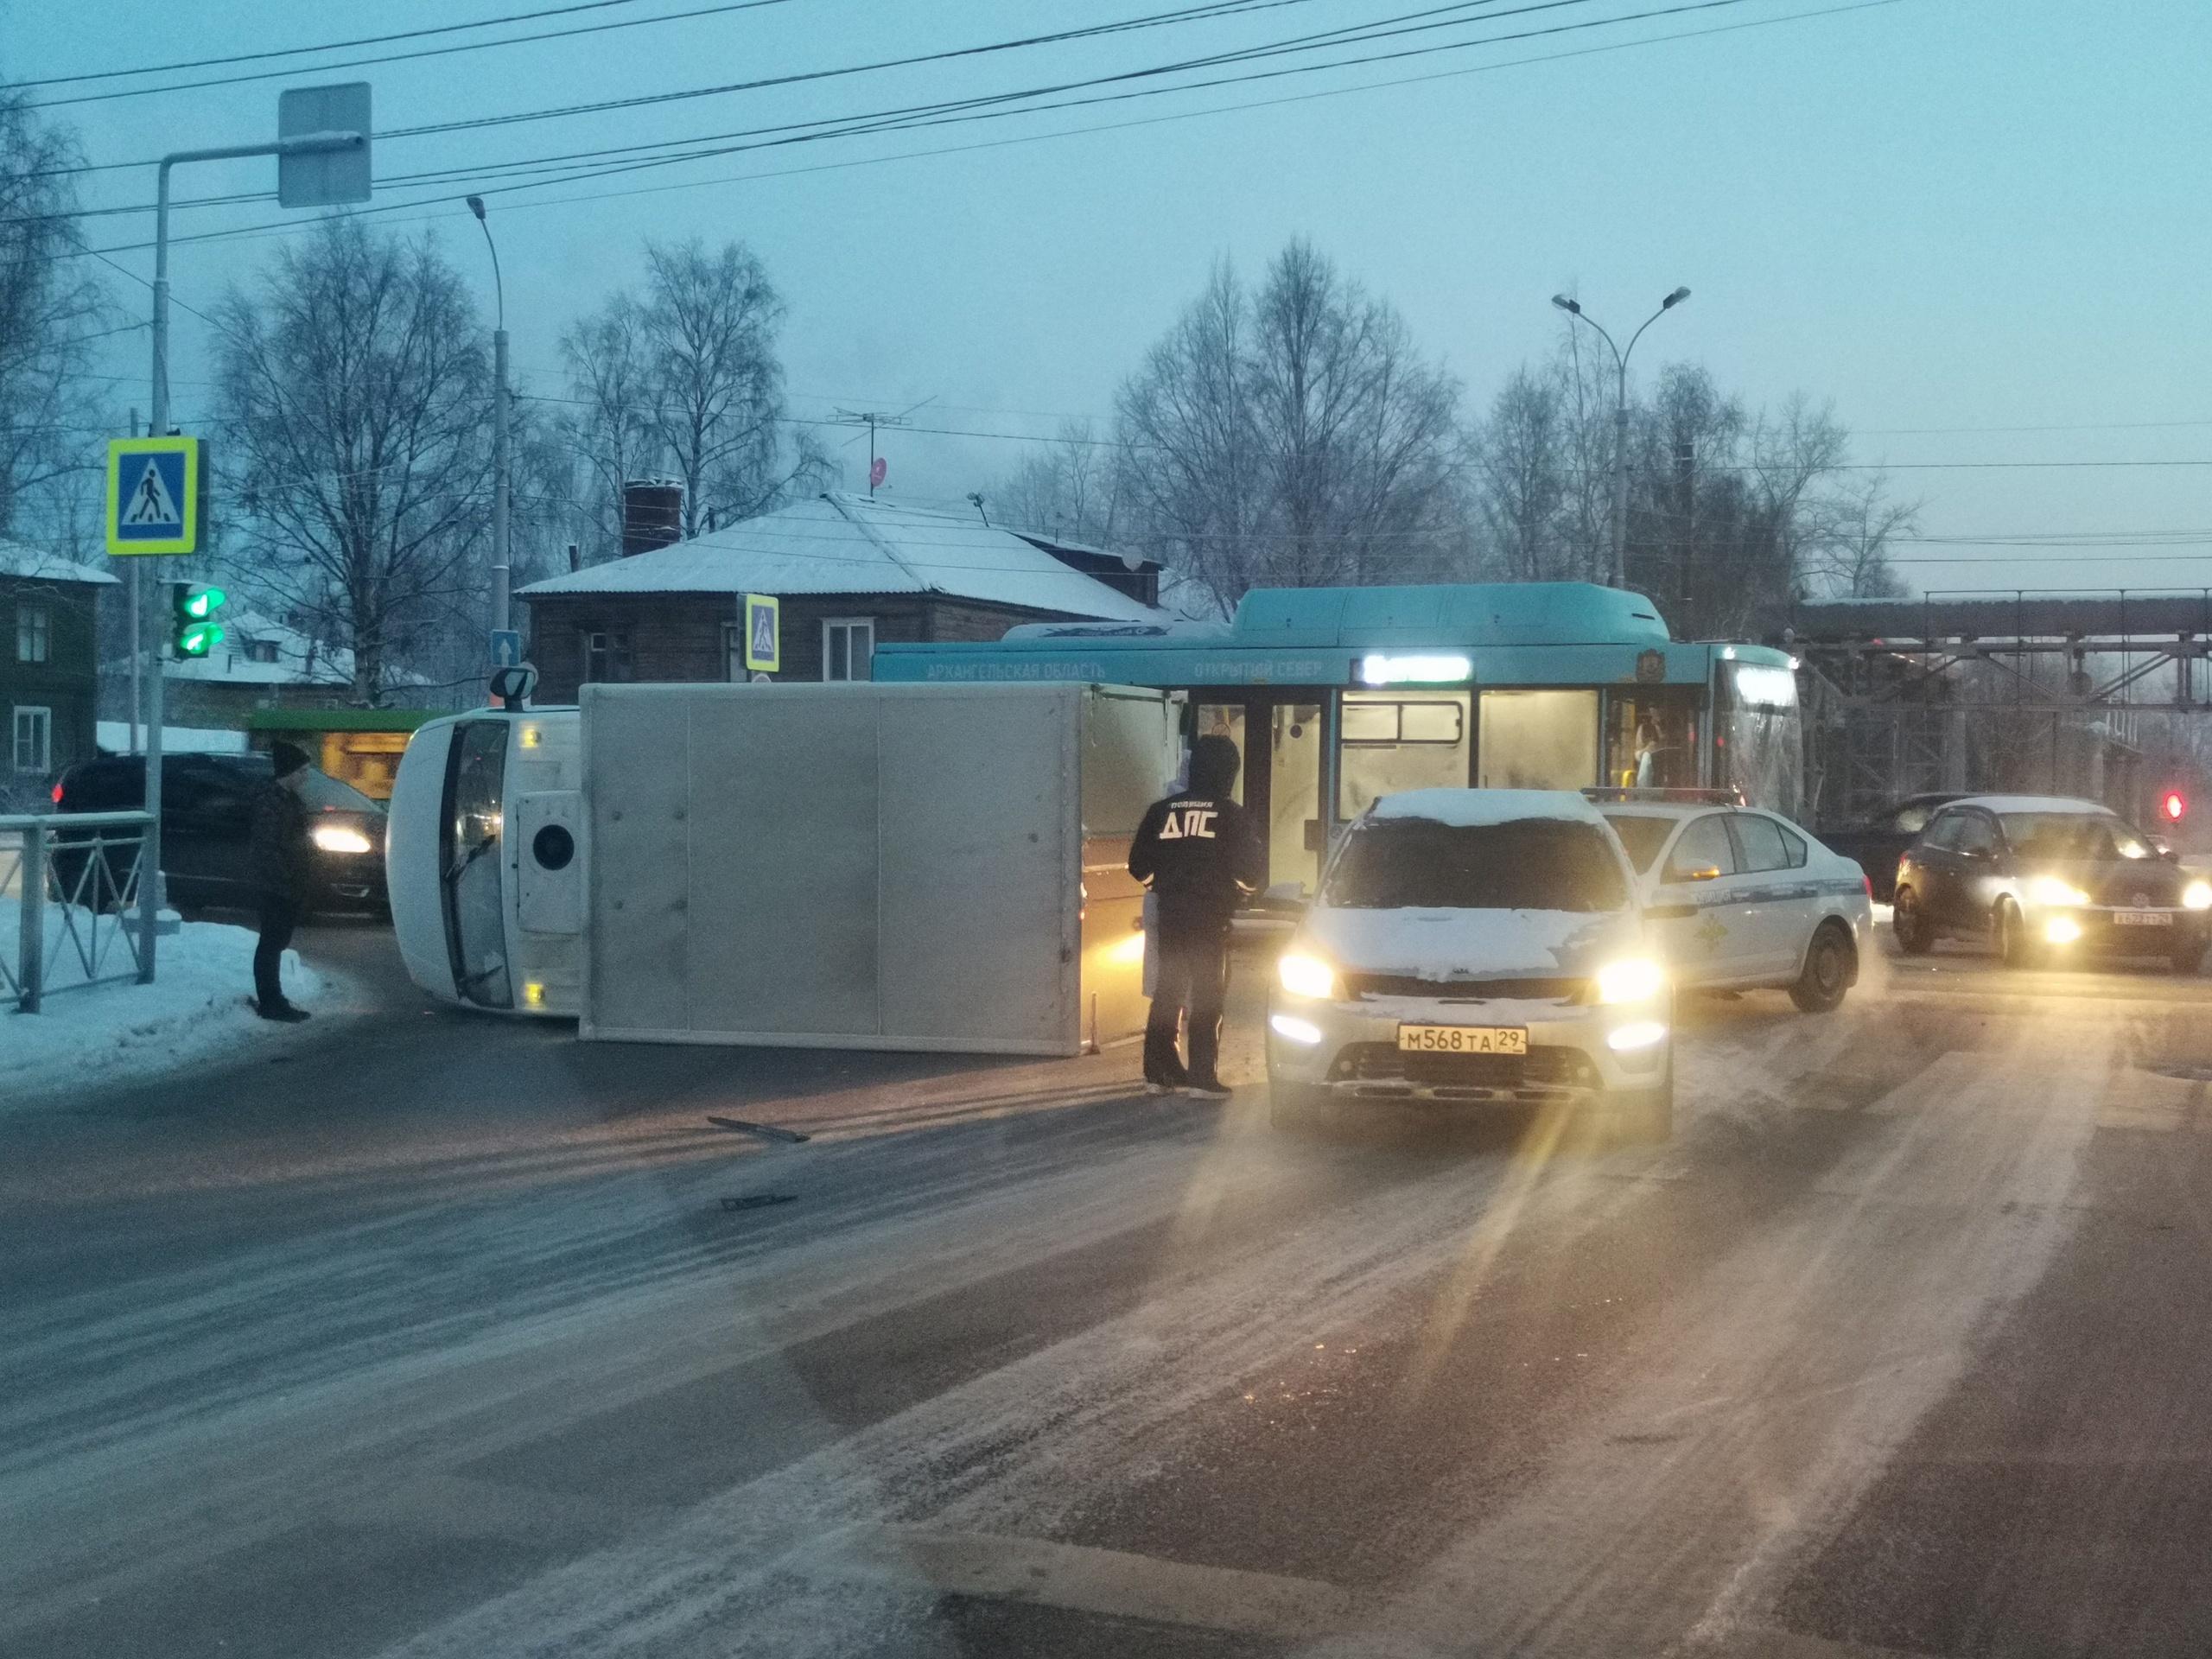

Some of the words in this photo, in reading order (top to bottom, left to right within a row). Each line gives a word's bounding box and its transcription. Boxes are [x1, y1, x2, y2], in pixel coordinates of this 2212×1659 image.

[927, 663, 1040, 679] АРХАНГЕЛЬСКАЯ
[1044, 662, 1106, 678] ОБЛАСТЬ
[1277, 661, 1323, 677] СЕВЕР
[1160, 810, 1218, 840] ДПС
[1407, 1030, 1492, 1052] М568ТА
[1498, 1031, 1520, 1047] 29
